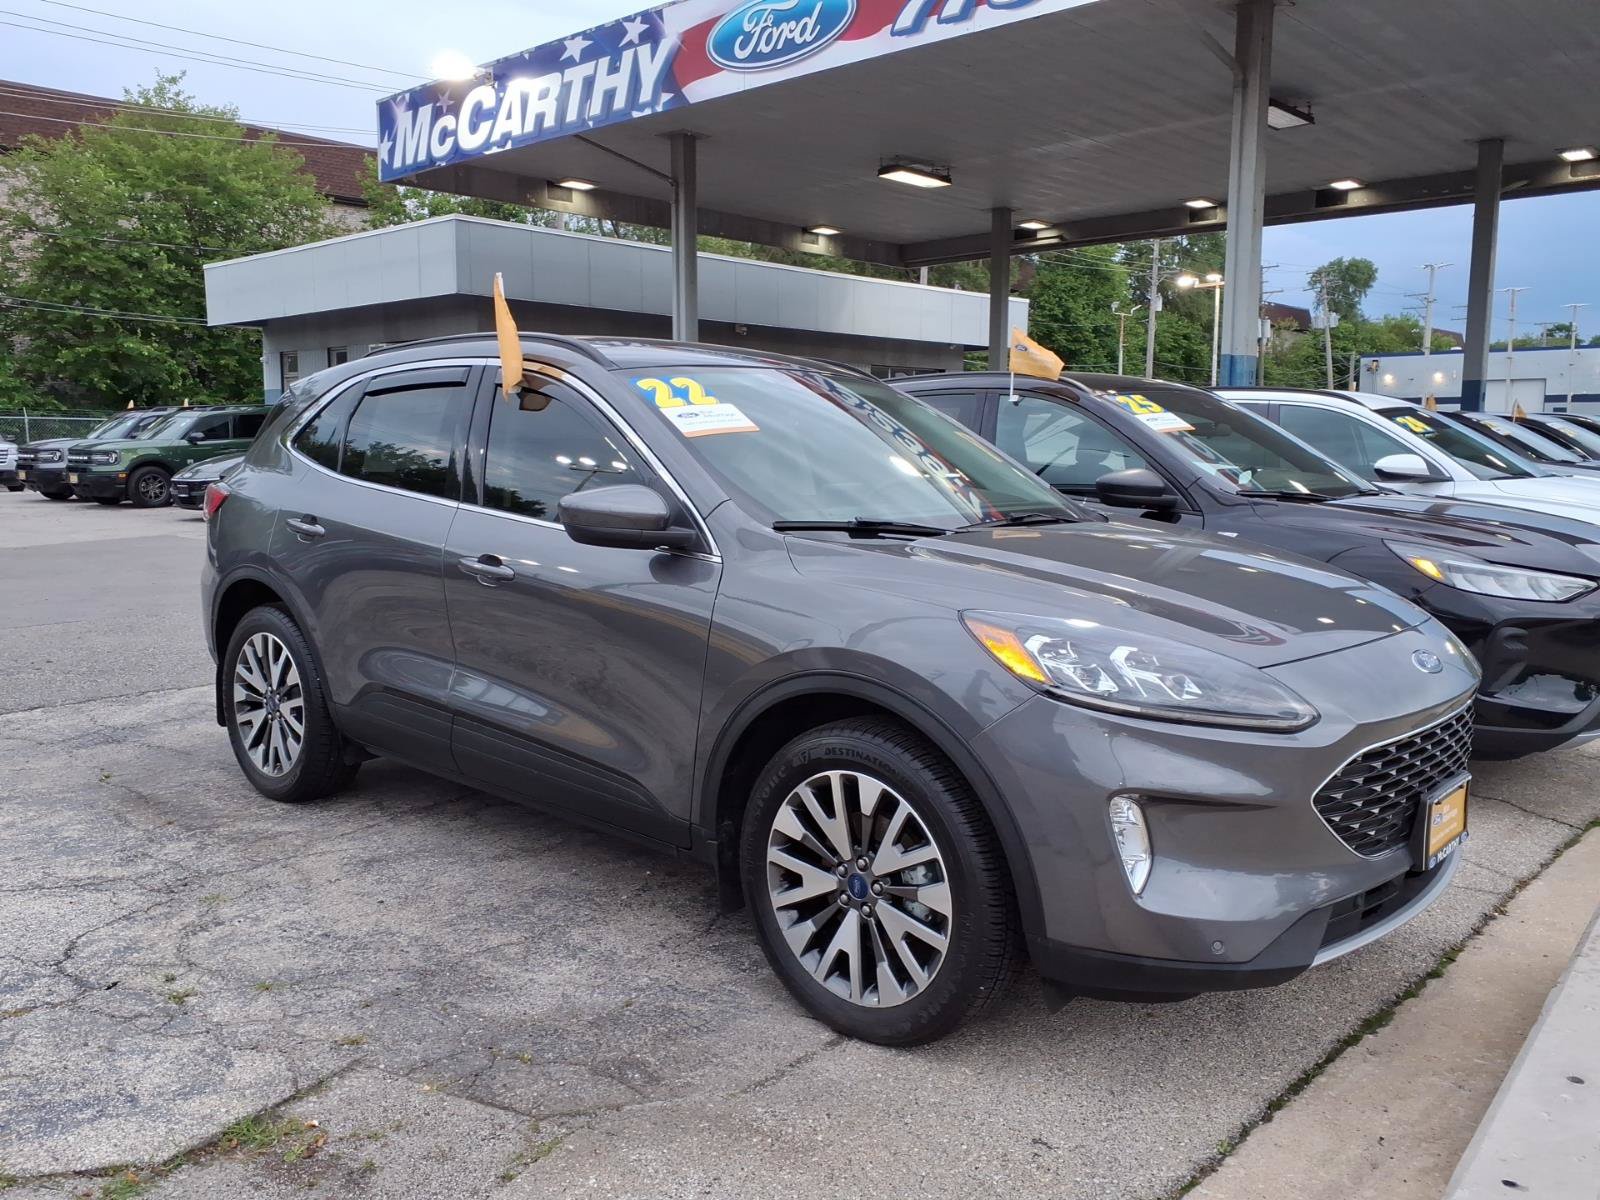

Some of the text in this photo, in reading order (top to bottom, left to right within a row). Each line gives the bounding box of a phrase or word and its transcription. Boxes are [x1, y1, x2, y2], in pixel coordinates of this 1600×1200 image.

[734, 1, 822, 60] Ford
[392, 38, 676, 169] McCARTHY
[636, 376, 721, 408] 22
[1116, 394, 1164, 414] 25
[824, 746, 898, 775] DESTINATION
